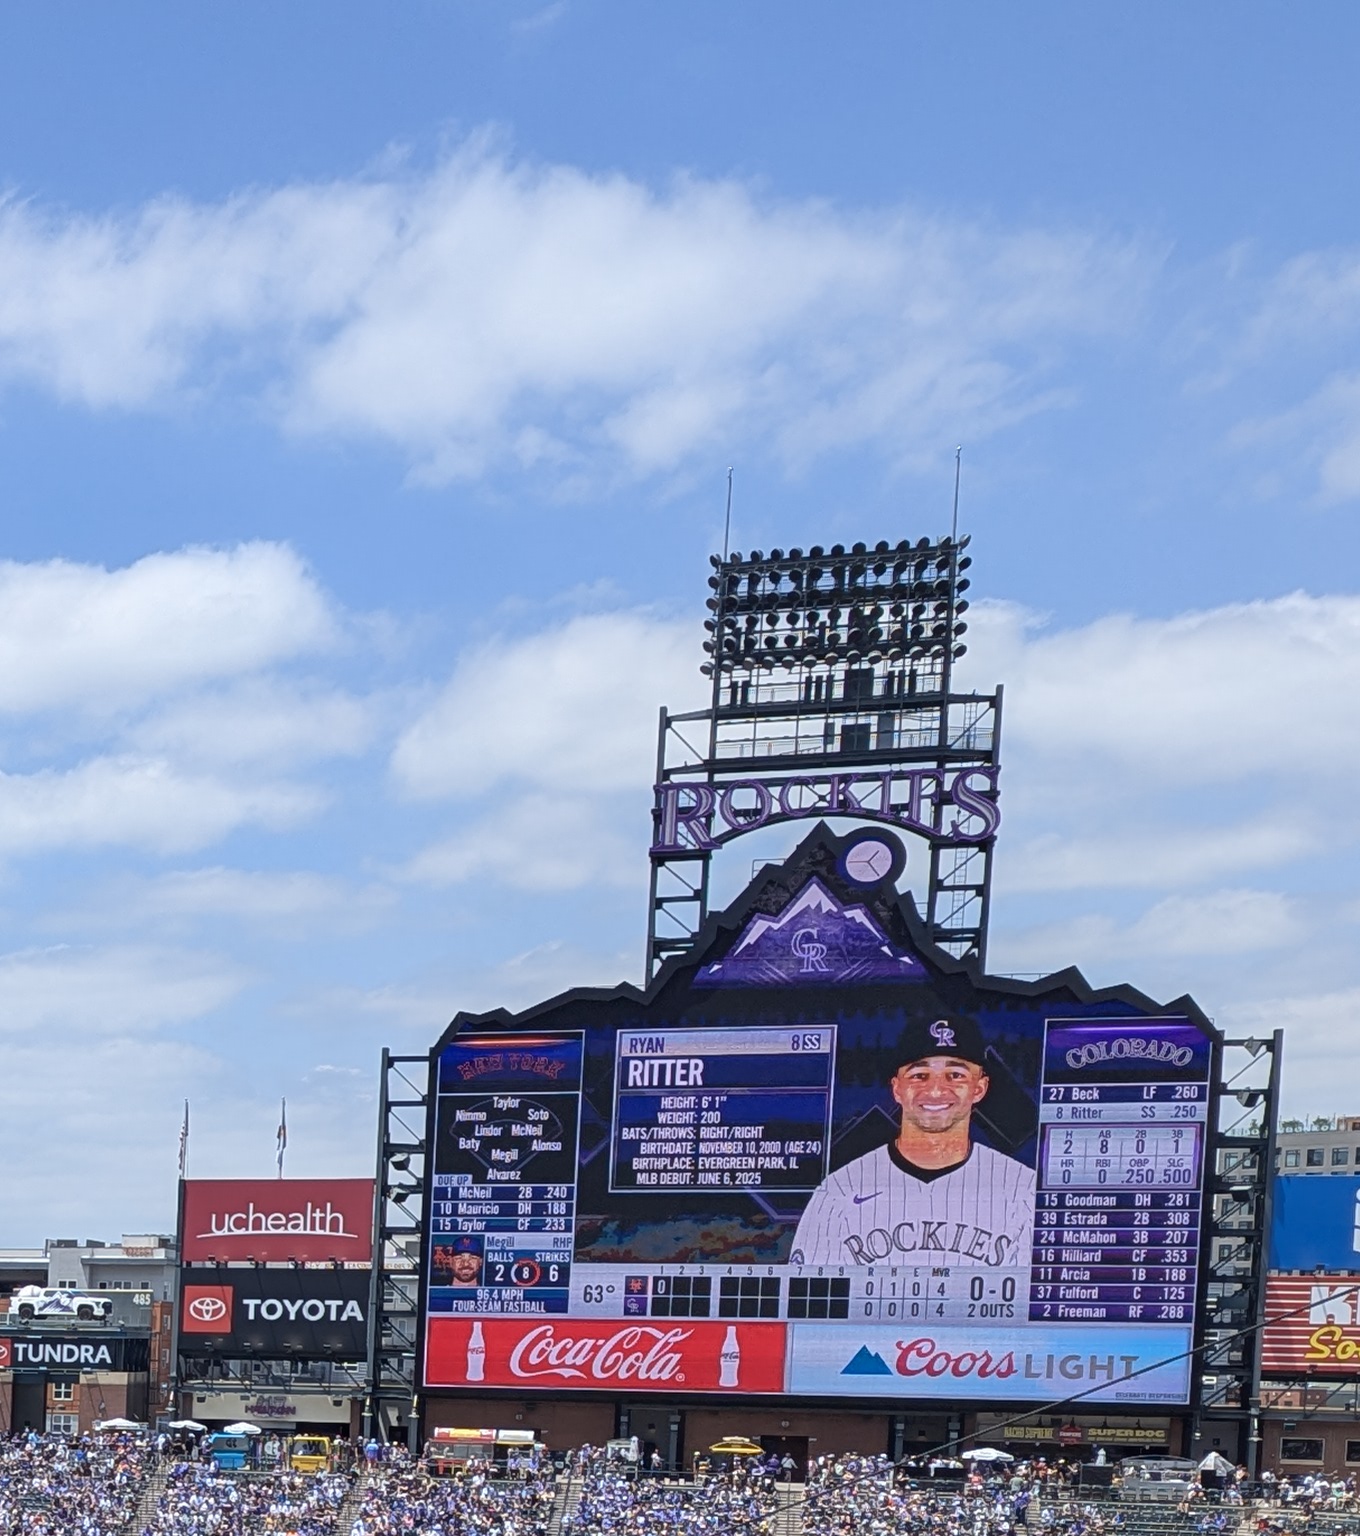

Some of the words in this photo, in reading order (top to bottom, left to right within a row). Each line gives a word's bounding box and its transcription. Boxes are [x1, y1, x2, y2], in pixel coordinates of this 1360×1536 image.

[649, 766, 1001, 852] ROCKIES
[629, 1037, 665, 1053] RYAN
[1065, 1037, 1194, 1068] COLORADO
[457, 1053, 504, 1080] NEW
[508, 1053, 565, 1080] YORK
[628, 1059, 704, 1087] RITTER
[1049, 1087, 1064, 1100] 27
[1071, 1087, 1100, 1100] Beck
[1143, 1087, 1157, 1100] LF
[1171, 1087, 1198, 1100] .260
[493, 1096, 520, 1110] Taylor
[661, 1096, 698, 1109] HEIGHT:
[528, 1108, 549, 1121] Soto
[657, 1112, 698, 1124] WEIGHT:
[700, 1111, 721, 1124] 200
[1071, 1106, 1104, 1119] Ritter
[1141, 1106, 1155, 1119] SS
[1170, 1106, 1197, 1119] .250
[474, 1124, 503, 1137] Lindor
[511, 1124, 543, 1137] McNeil
[621, 1127, 696, 1140] BATS/THROWS:
[699, 1126, 764, 1139] RIGHT/RIGHT
[458, 1137, 481, 1151] Baty
[532, 1139, 562, 1151] Alonso
[640, 1142, 695, 1155] BIRTHDATE:
[698, 1141, 743, 1154] NOVEMBER
[491, 1148, 519, 1163] Megill
[632, 1157, 695, 1170] BIRTHPLACE:
[698, 1157, 755, 1169] EVERGREEN
[757, 1157, 787, 1170] PARK,
[486, 1168, 521, 1181] Alvarez
[636, 1172, 658, 1185] MLB
[660, 1172, 694, 1184] DEBUT:
[696, 1172, 720, 1185] JUNE
[735, 1172, 761, 1184] 2025
[1121, 1170, 1154, 1184] .250
[1158, 1170, 1192, 1183] .500
[458, 1187, 492, 1198] McNeil
[1044, 1195, 1058, 1206] 15
[1065, 1195, 1116, 1206] Goodman
[1135, 1195, 1151, 1206] DH
[1165, 1195, 1190, 1206] .281
[457, 1203, 499, 1214] Mauricio
[517, 1203, 531, 1214] DH
[211, 1202, 344, 1235] uchealth
[1042, 1213, 1057, 1225] 39
[1064, 1213, 1107, 1225] Estrada
[1133, 1213, 1150, 1225] 2B
[1163, 1213, 1190, 1225] .308
[457, 1219, 487, 1232] Taylor
[486, 1236, 515, 1250] Megill
[552, 1236, 572, 1248] RHP
[1040, 1231, 1056, 1243] 24
[1063, 1231, 1116, 1243] McMahon
[1133, 1231, 1148, 1243] 3B
[1162, 1231, 1189, 1243] .207
[843, 1221, 1012, 1267] ROCKIES
[487, 1252, 514, 1263] BALLS
[535, 1252, 570, 1263] STRIKES
[1041, 1249, 1055, 1262] 16
[1061, 1249, 1102, 1262] Hilliard
[1132, 1249, 1147, 1262] CF
[1161, 1249, 1187, 1262] .353
[1060, 1268, 1090, 1280] Arcia
[476, 1289, 498, 1300] 96.4
[501, 1289, 524, 1300] MPH
[1037, 1286, 1052, 1299] 37
[1059, 1286, 1099, 1299] Fulford
[132, 1293, 151, 1307] 485
[452, 1301, 502, 1312] FOUR-SEAM
[503, 1301, 546, 1312] FASTBALL
[242, 1298, 365, 1322] TOYOTA
[980, 1303, 1015, 1318] OUTS
[1058, 1305, 1107, 1318] Freeman
[14, 1343, 113, 1365] TUNDRA
[510, 1325, 695, 1381] Coca-Cola
[895, 1338, 1018, 1379] Coors
[1024, 1354, 1140, 1380] LIGHT
[1087, 1428, 1133, 1437] SUPER
[1135, 1429, 1165, 1438] DOG
